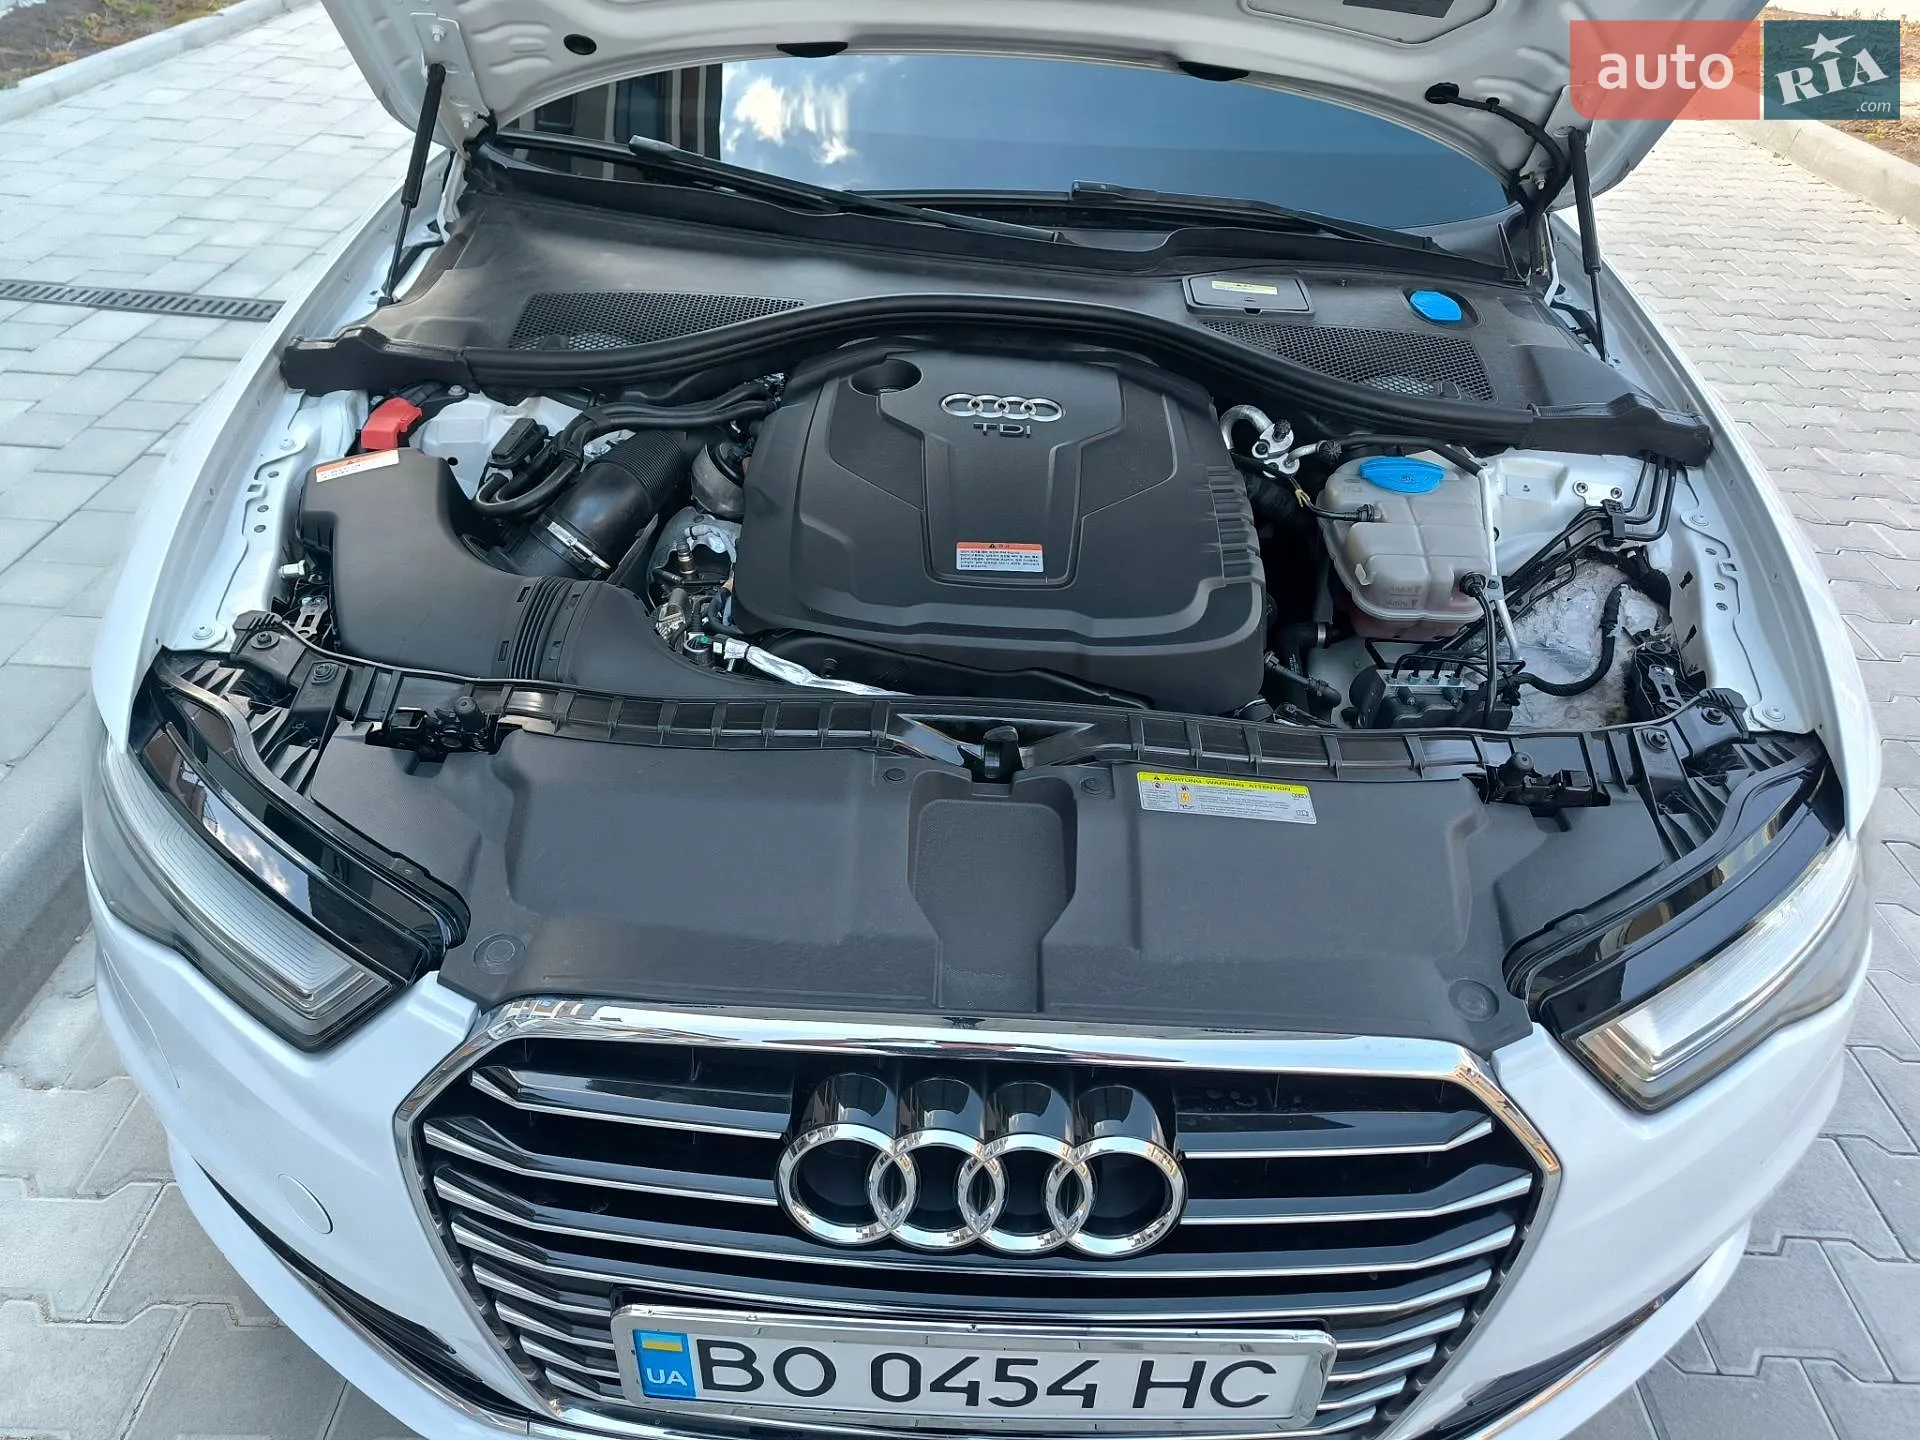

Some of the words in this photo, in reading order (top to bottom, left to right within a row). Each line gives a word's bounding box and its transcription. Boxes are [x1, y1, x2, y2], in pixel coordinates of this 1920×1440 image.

[973, 422, 1032, 438] TDI
[647, 1367, 687, 1386] UA
[696, 1338, 837, 1398] BO
[869, 1352, 1100, 1409] 0454
[1132, 1359, 1276, 1410] HC
